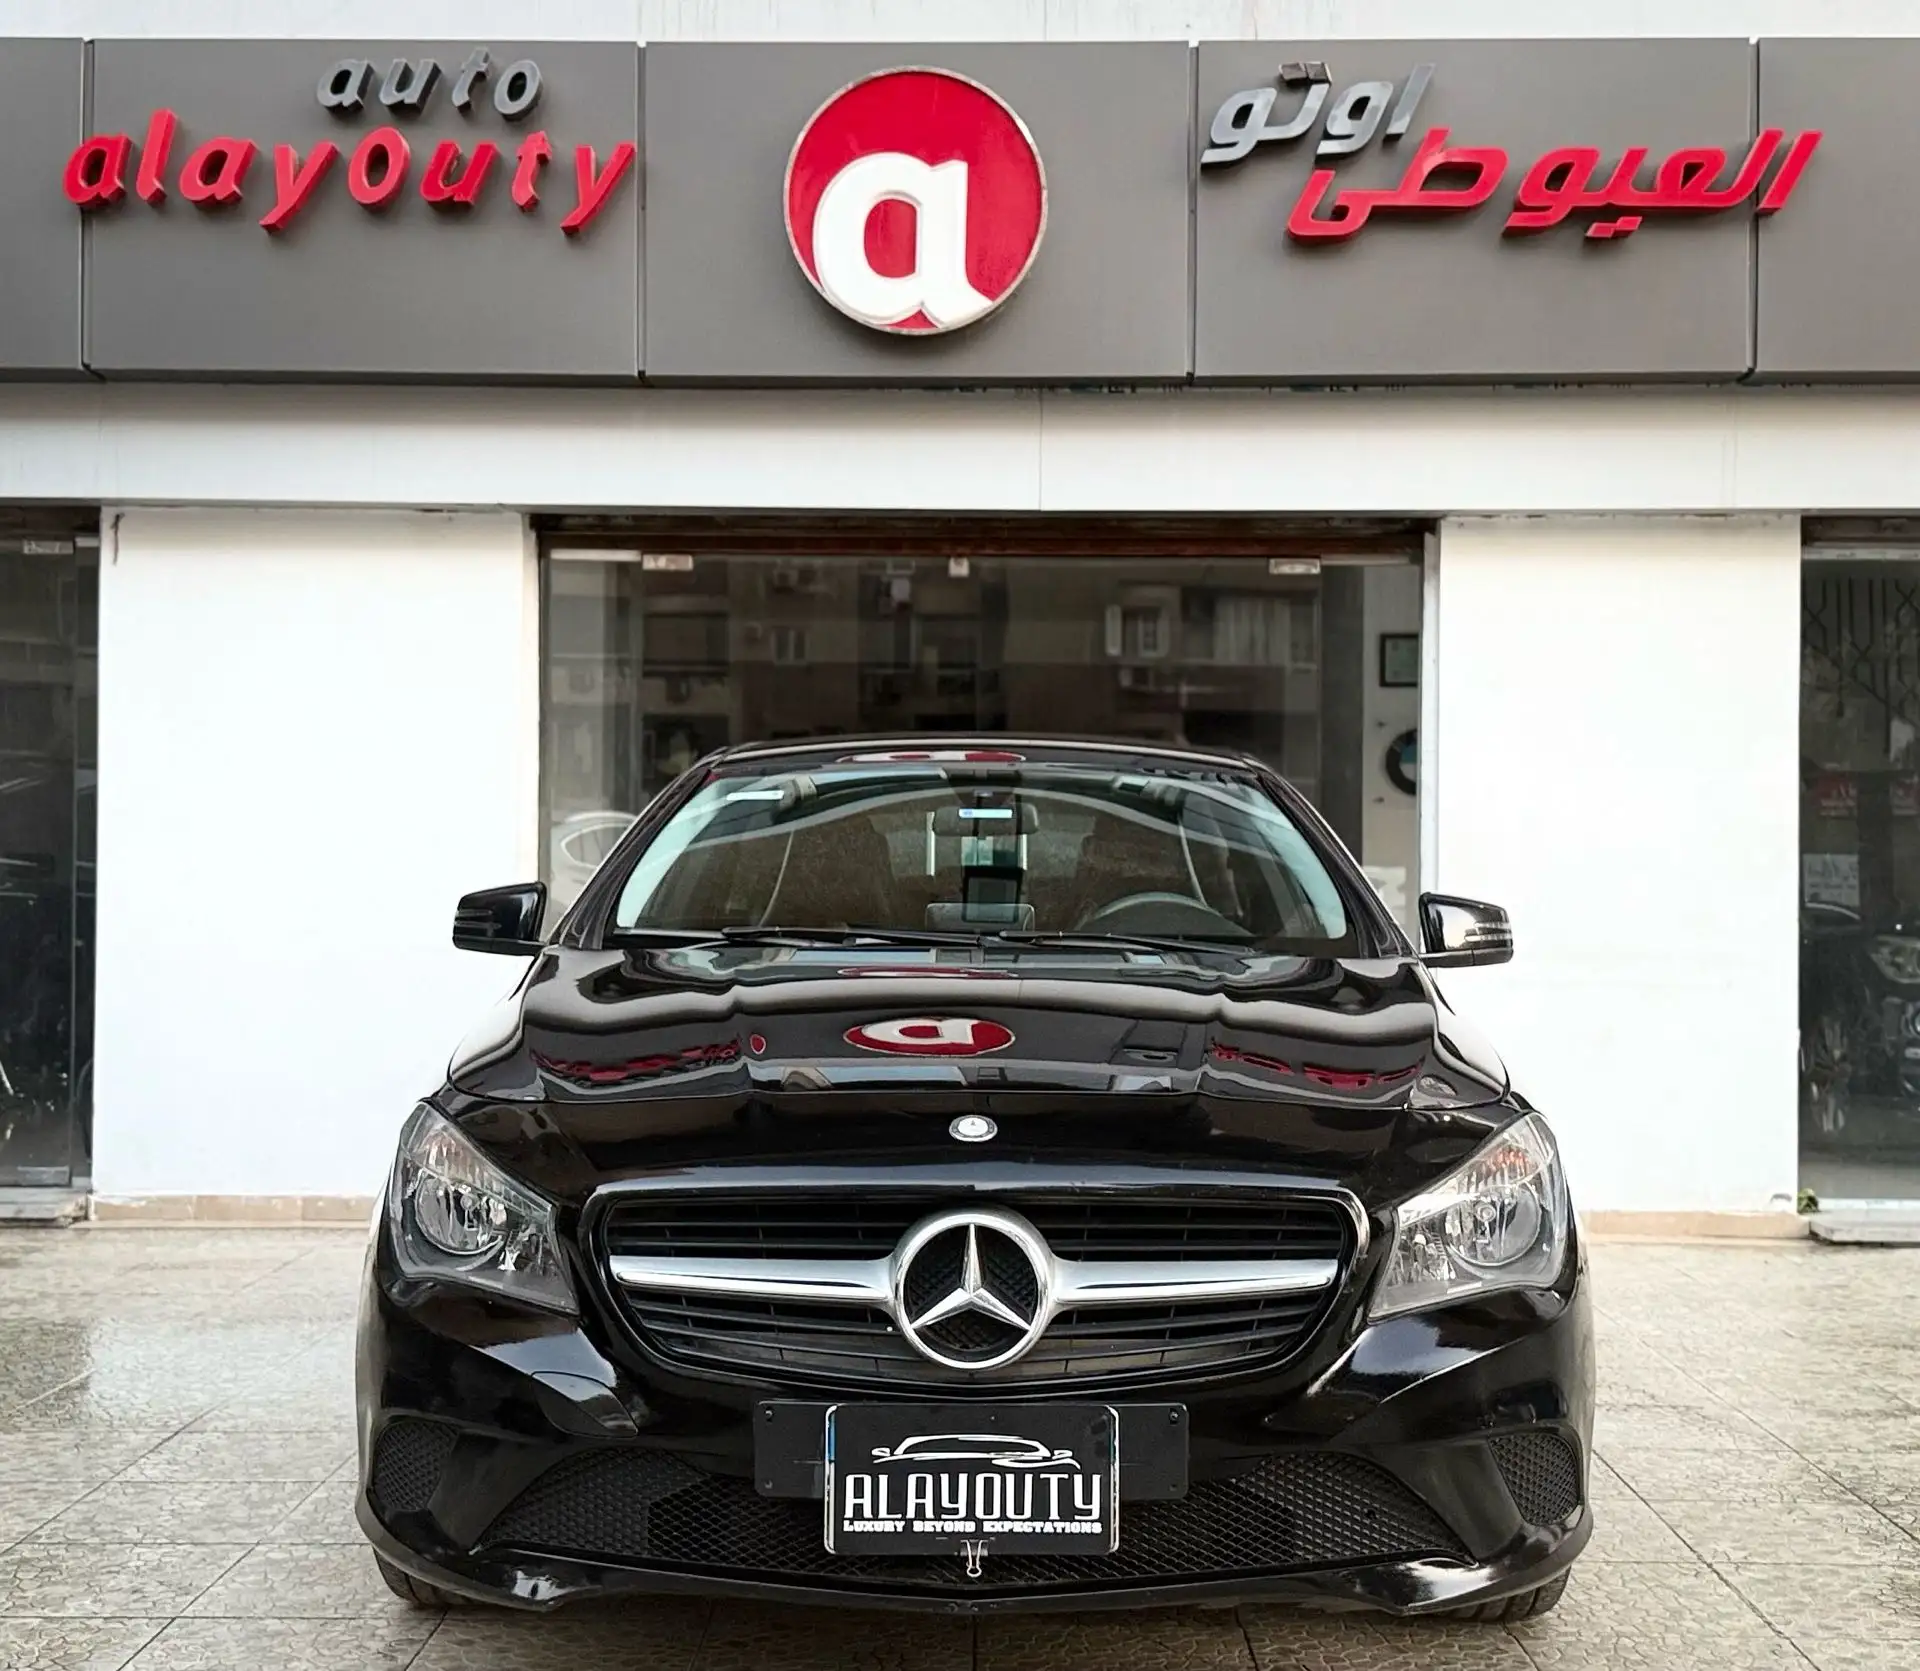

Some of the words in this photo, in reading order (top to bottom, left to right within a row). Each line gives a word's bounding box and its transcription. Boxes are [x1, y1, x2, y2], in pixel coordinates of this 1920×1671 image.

[317, 47, 543, 118] auto
[1200, 61, 1436, 167] اوتو
[63, 109, 636, 234] alayouty
[812, 151, 995, 329] a
[843, 1472, 1102, 1521] ALAYOUTY
[843, 1520, 905, 1533] LUXURY
[912, 1520, 976, 1533] BEYOND
[982, 1520, 1103, 1534] EXPECTATIONS
